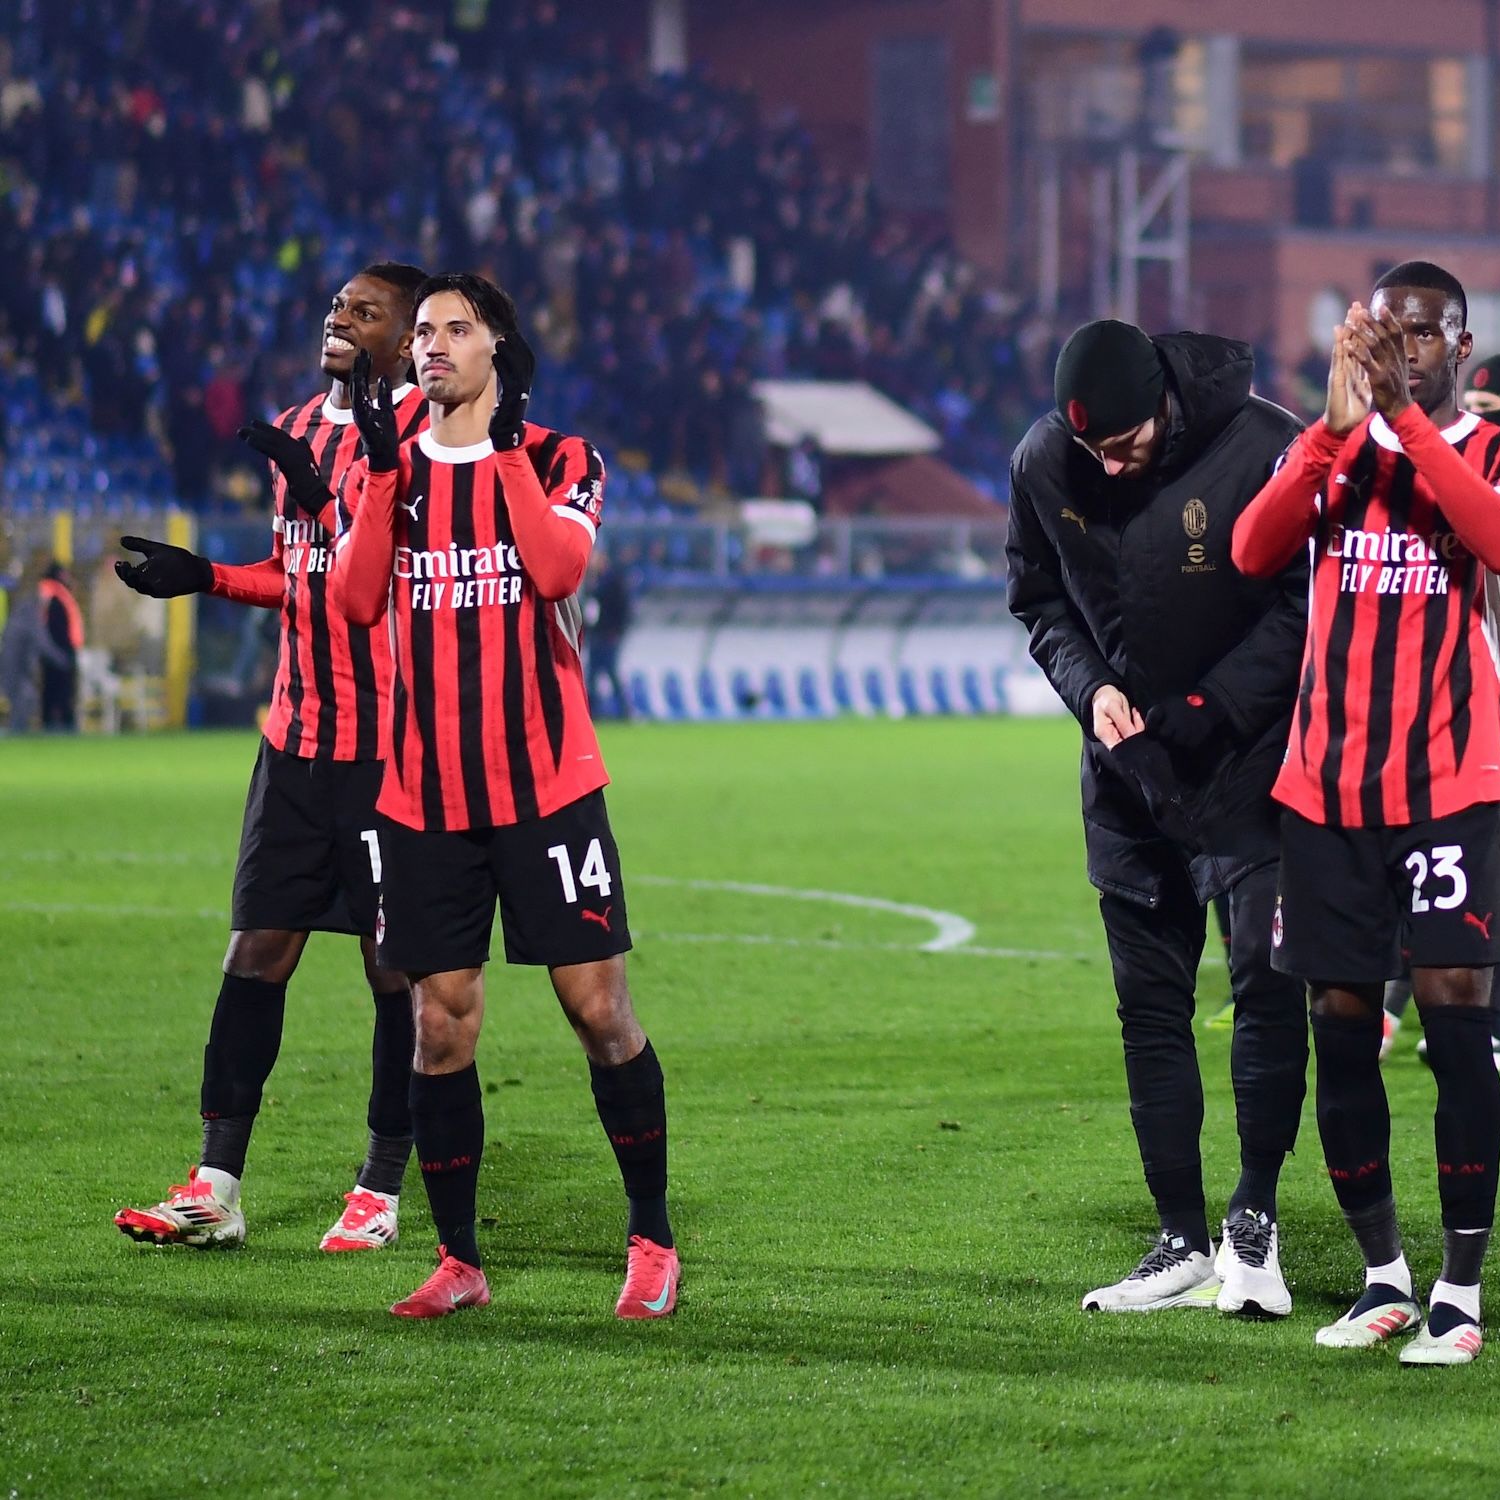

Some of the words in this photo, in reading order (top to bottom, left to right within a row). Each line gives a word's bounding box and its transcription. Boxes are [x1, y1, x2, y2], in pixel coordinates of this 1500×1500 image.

[412, 583, 446, 611] FLY
[451, 576, 522, 609] BETTER
[1341, 563, 1373, 593] FLY
[1376, 565, 1449, 595] BETTER
[547, 837, 612, 904] 14
[1405, 845, 1467, 913] 23
